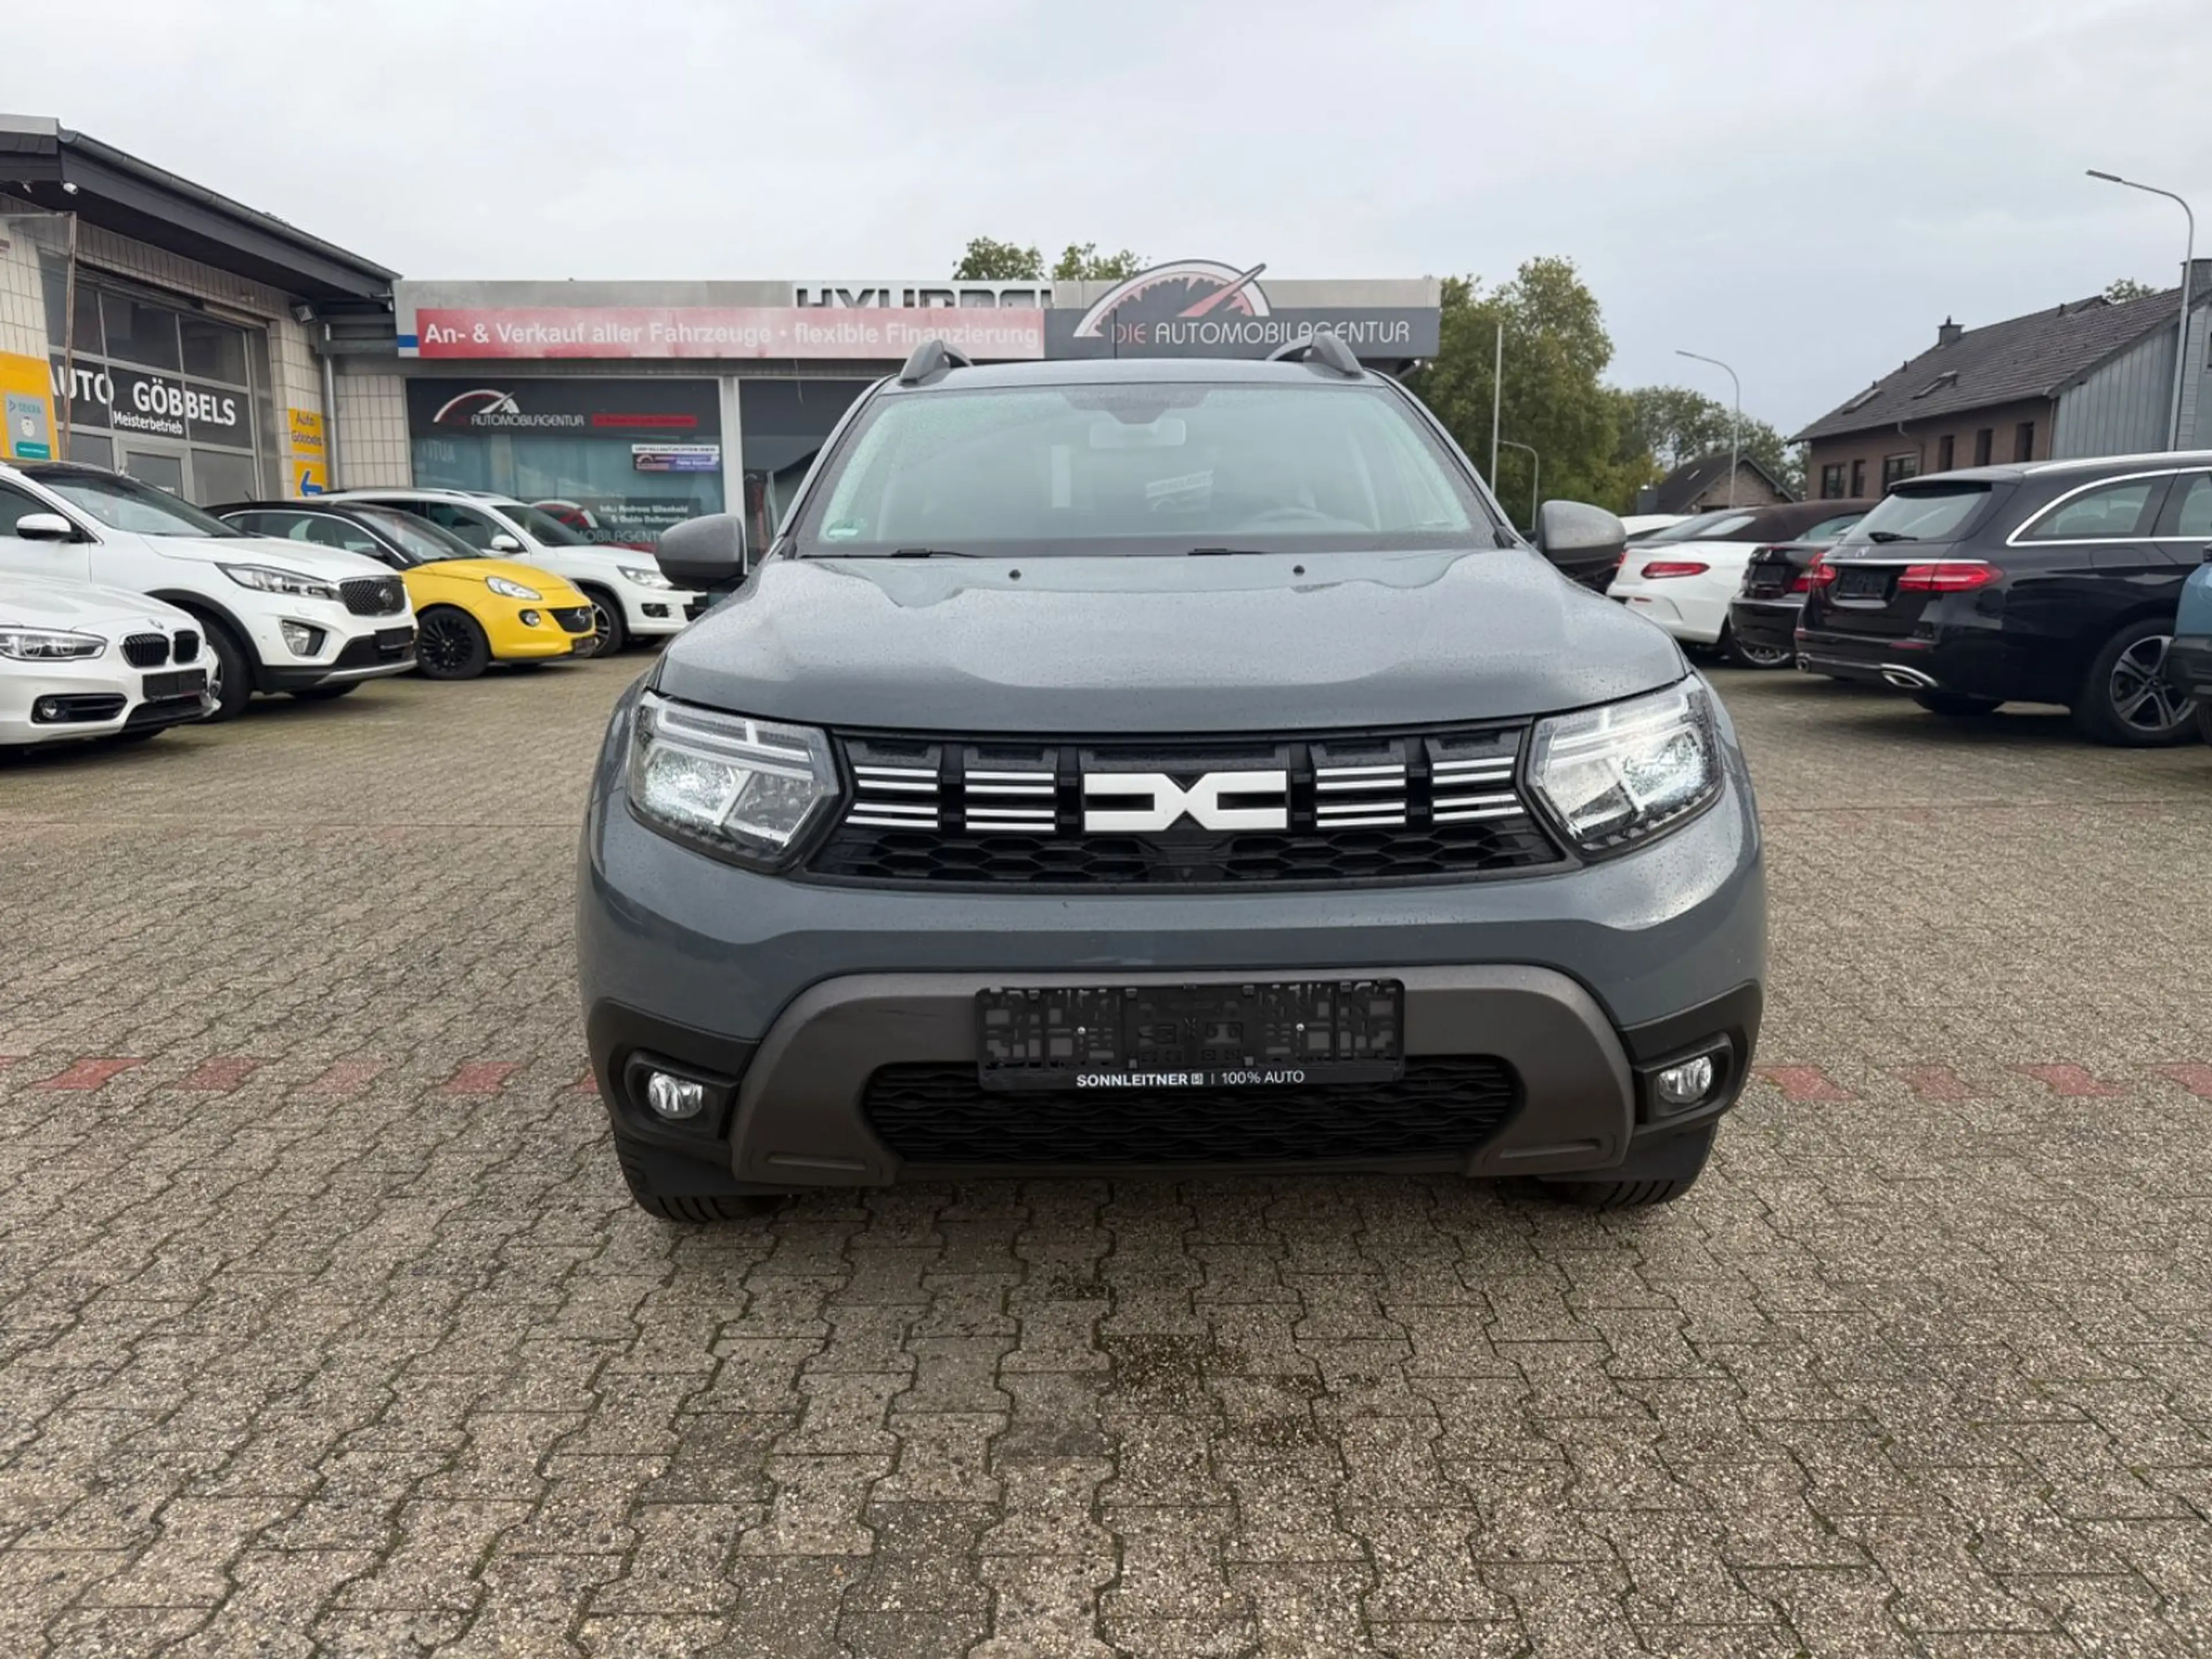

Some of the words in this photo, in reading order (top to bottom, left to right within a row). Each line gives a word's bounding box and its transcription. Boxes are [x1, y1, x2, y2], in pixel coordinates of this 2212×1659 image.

[425, 324, 465, 344] An-
[472, 324, 490, 344] &
[496, 322, 584, 344] Verkauf
[592, 322, 643, 344] aller
[650, 323, 771, 348] Fahrzeuge
[794, 322, 879, 343] flexible
[885, 322, 1040, 348] Finanzierung
[1111, 323, 1146, 344] DIE
[1154, 320, 1411, 344] AUTOMOBILAGENTUR
[132, 376, 236, 426] GÖBBELS
[112, 410, 183, 435] Meisterbetrieb
[471, 414, 585, 427] AUTOMOBILAGENTUR
[1076, 1073, 1188, 1088] SONNLEITNER
[1221, 1071, 1262, 1085] 100%
[1264, 1070, 1305, 1084] AUTO
